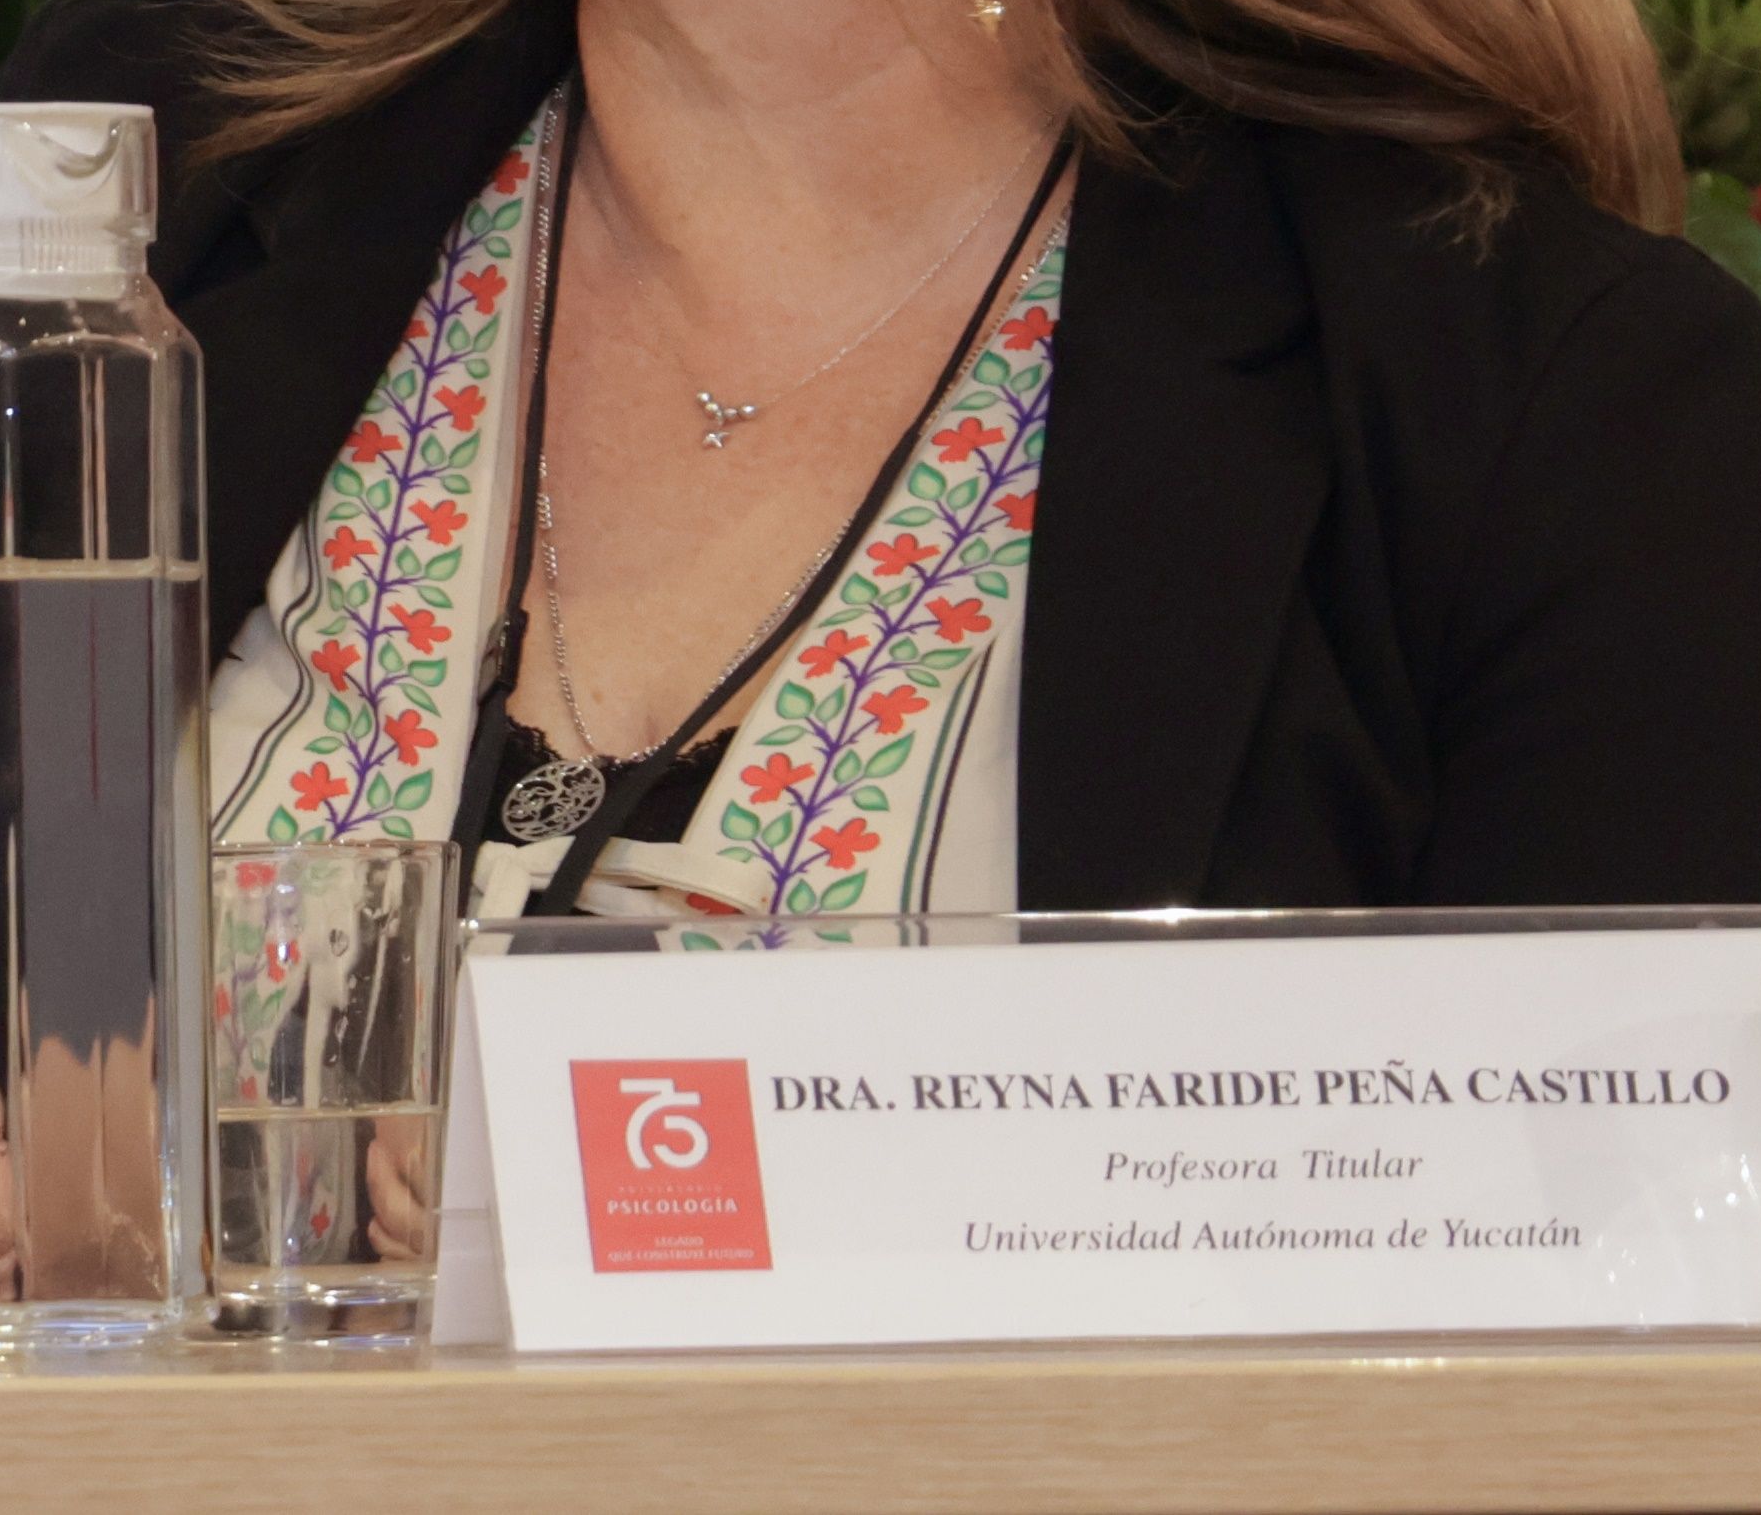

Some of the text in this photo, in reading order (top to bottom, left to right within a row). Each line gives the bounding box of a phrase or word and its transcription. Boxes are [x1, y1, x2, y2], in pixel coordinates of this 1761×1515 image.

[770, 1058, 1732, 1113] DRA. REYNA FARIDE PEÑA CASTILLO
[618, 1078, 709, 1170] 75
[1103, 1147, 1424, 1189] Profesora Titular
[964, 1216, 1582, 1253] Universidad Autónoma de Yucatán
